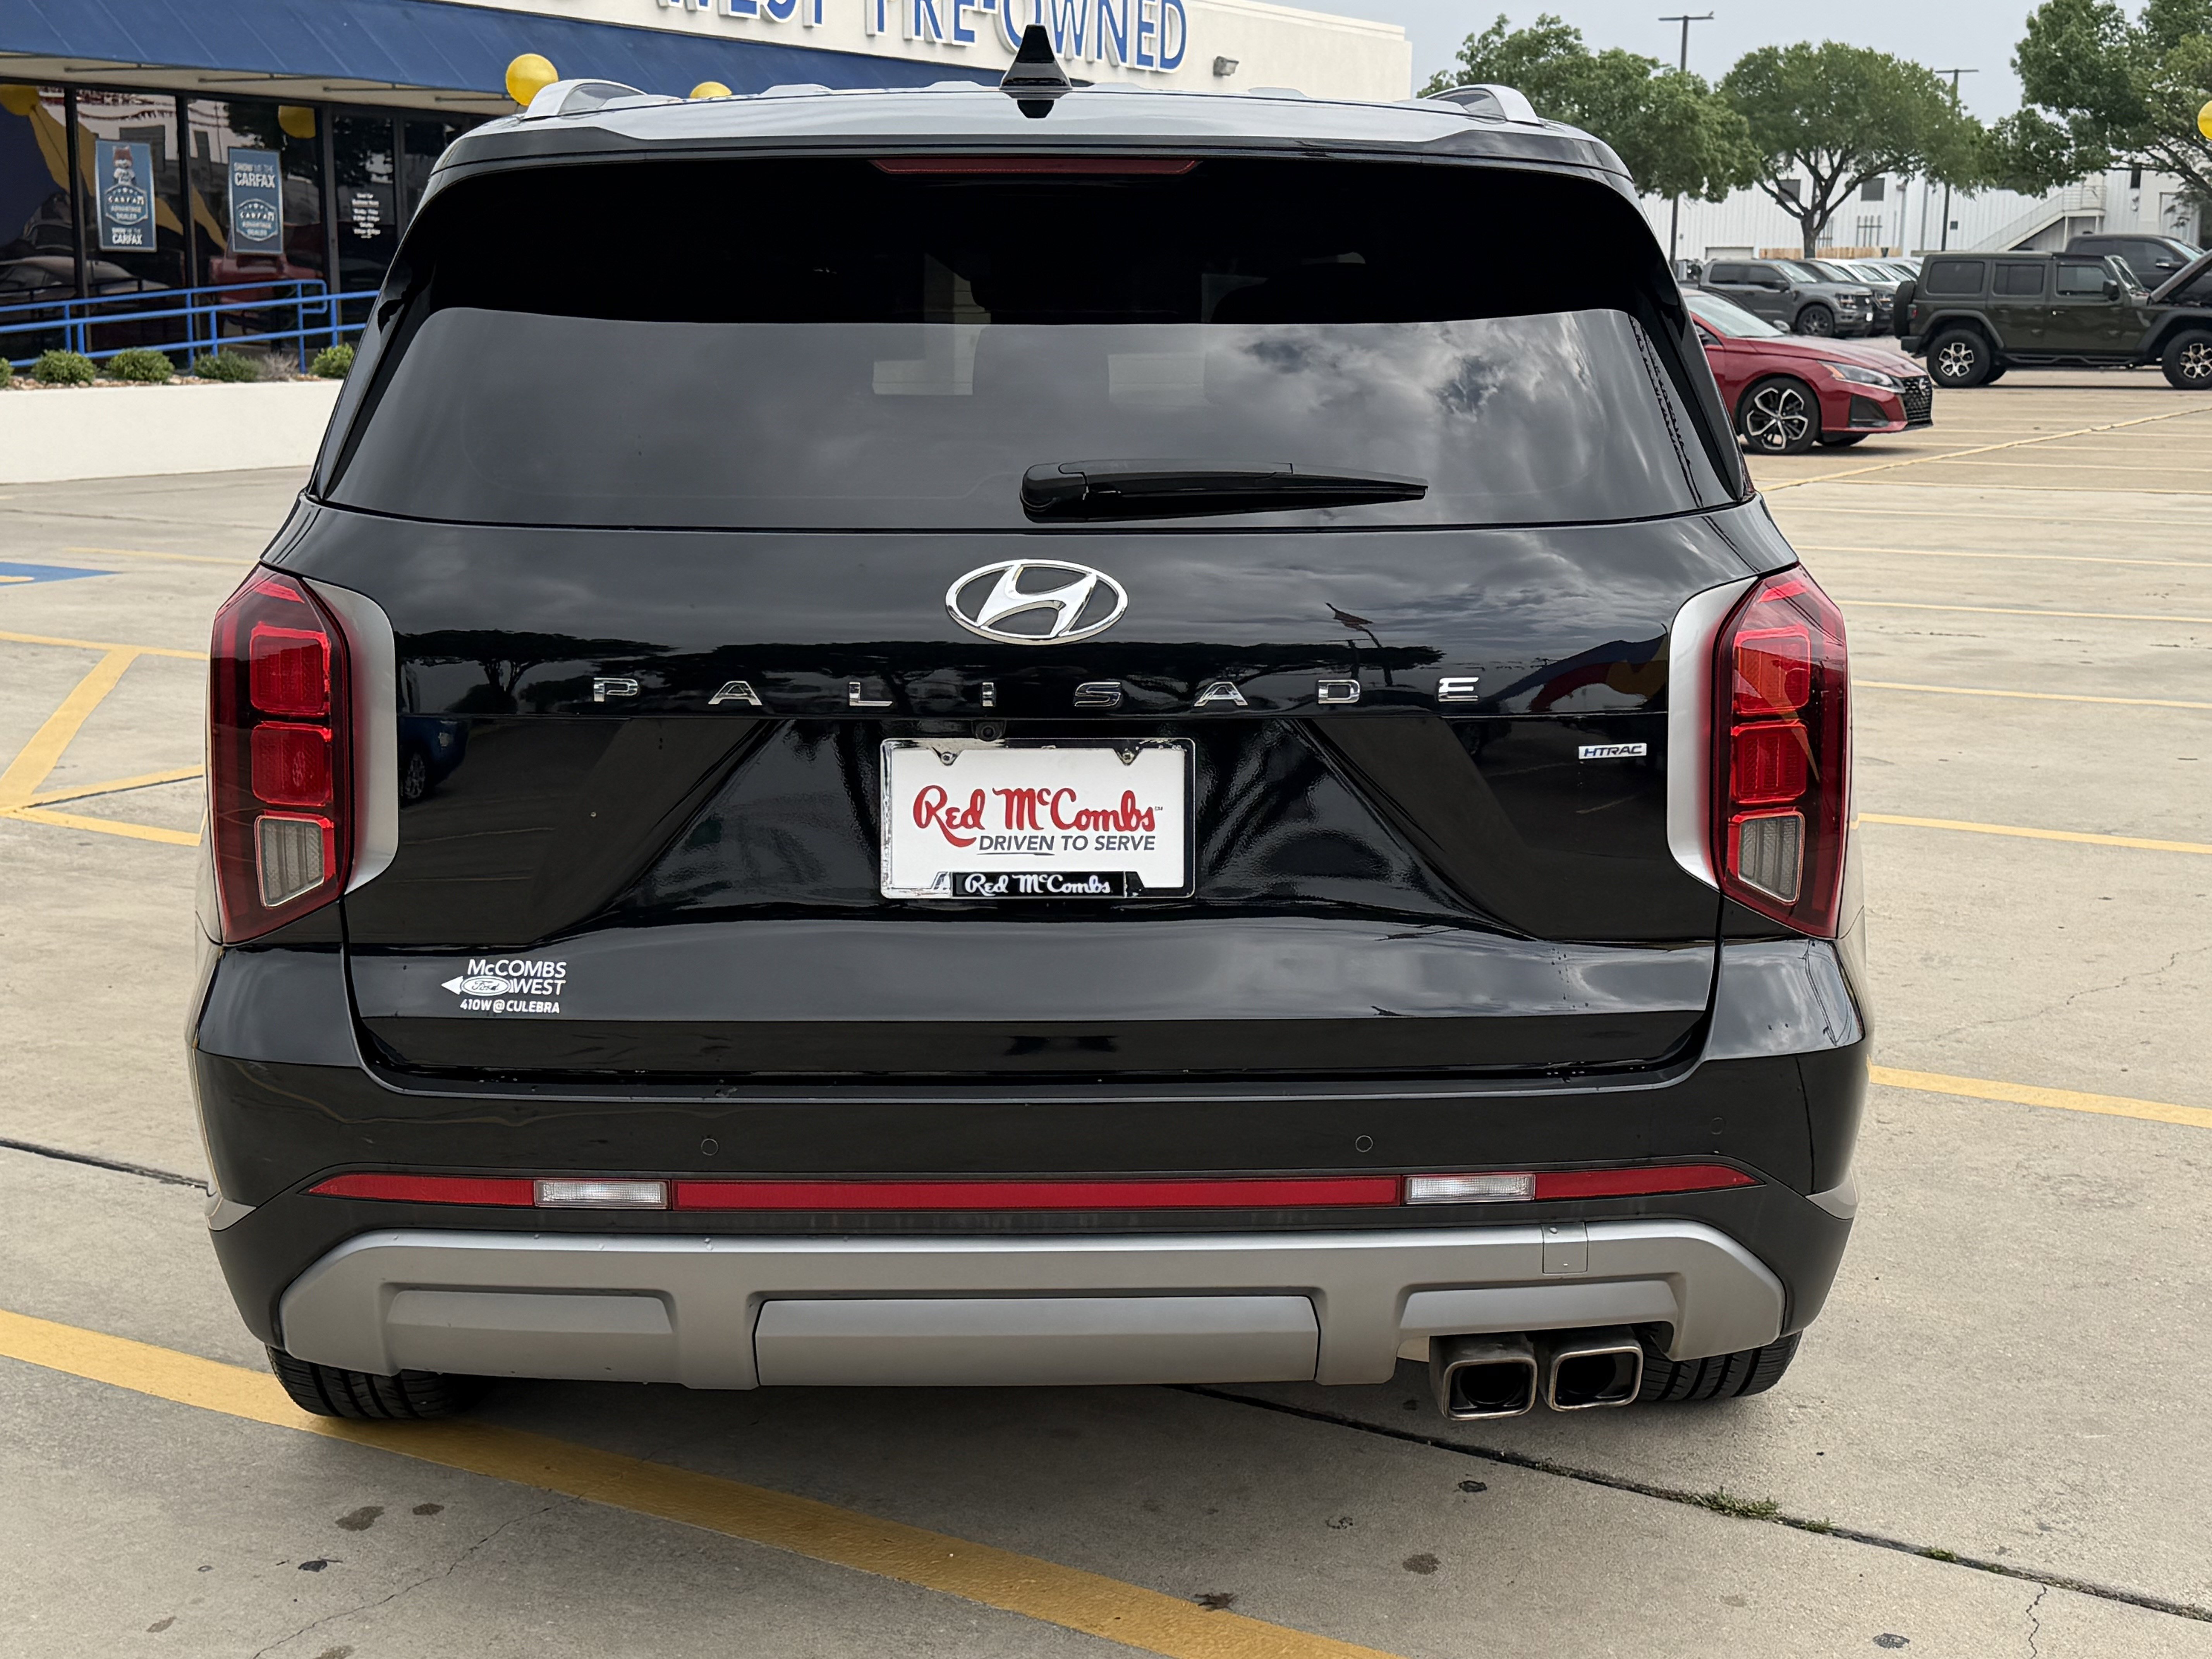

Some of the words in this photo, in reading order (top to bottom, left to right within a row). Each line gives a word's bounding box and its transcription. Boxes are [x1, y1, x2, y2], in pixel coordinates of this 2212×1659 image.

[235, 172, 276, 188] CARFAX
[112, 234, 143, 245] CARFAX
[594, 677, 1479, 707] PALISADE
[1583, 745, 1643, 757] HTRAC
[913, 785, 986, 848] Red
[979, 835, 1055, 851] DRIVEN
[1061, 835, 1089, 851] TO
[1094, 835, 1156, 851] SERVE
[965, 873, 1009, 896] Red
[1012, 874, 1110, 893] McCombs
[467, 959, 567, 978] McCOMBS
[512, 978, 566, 995] WEST
